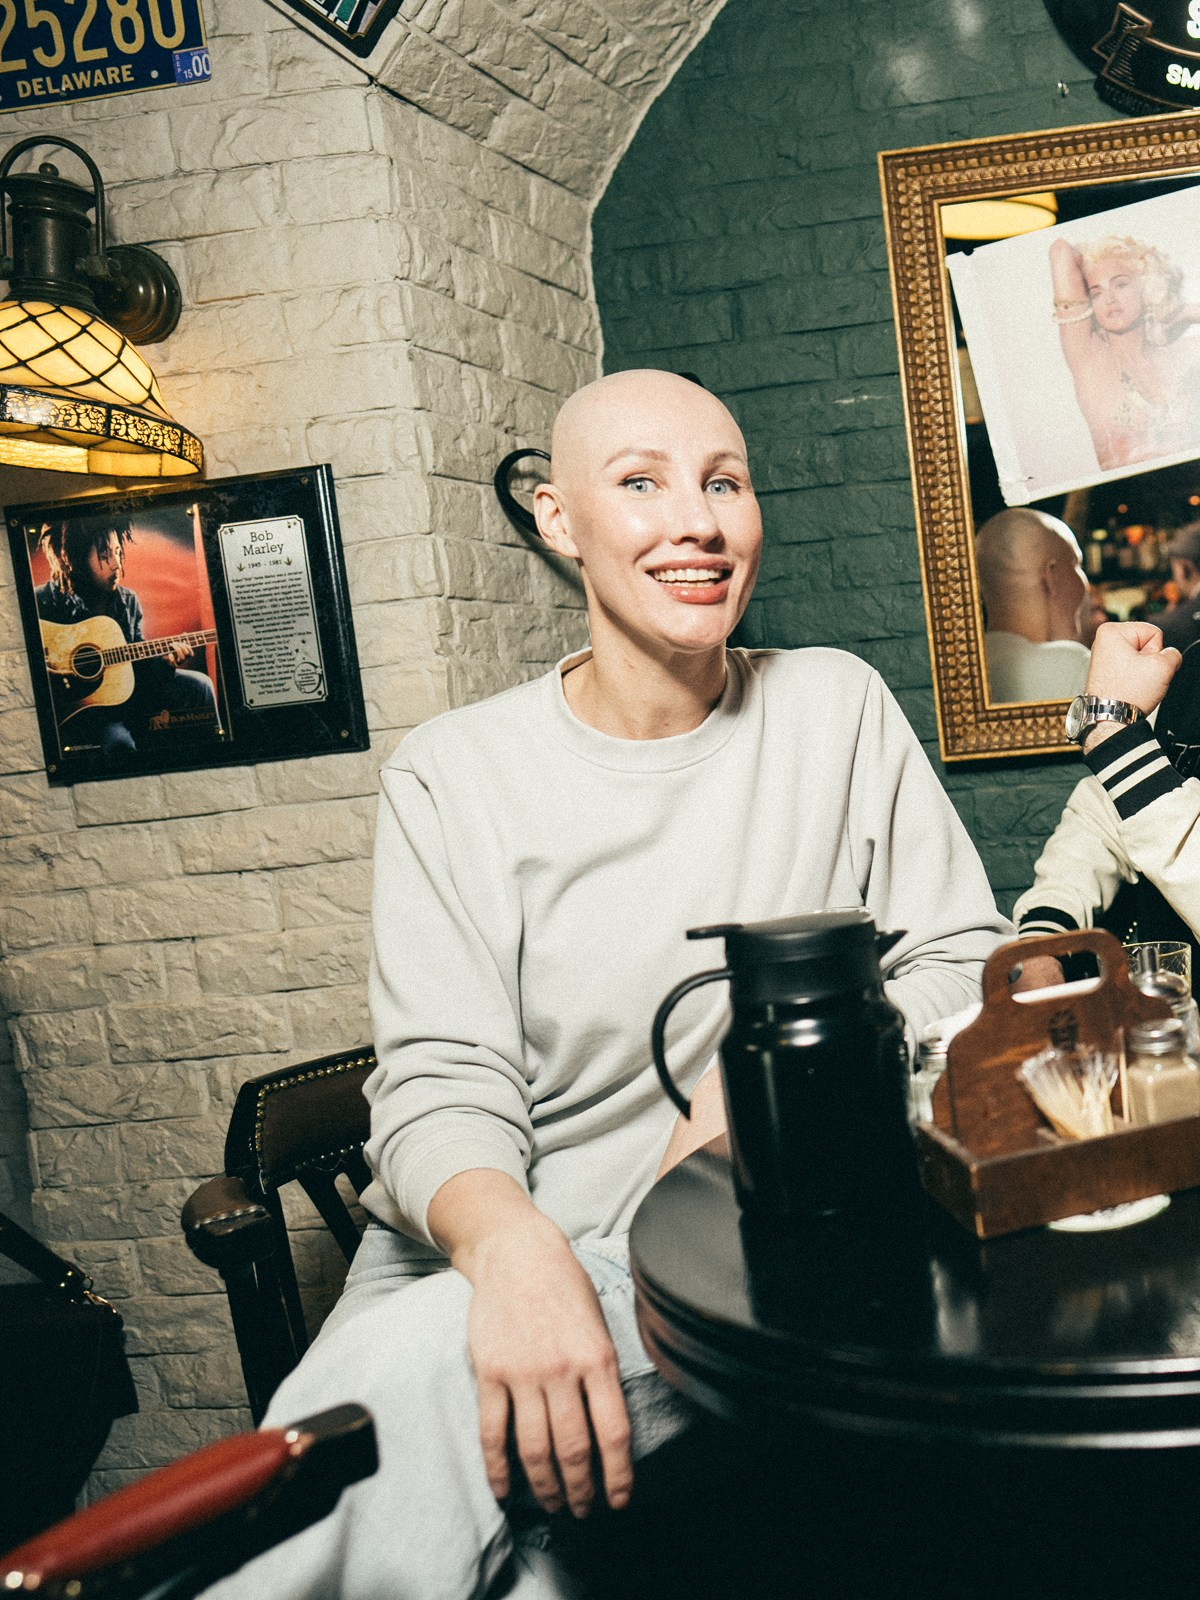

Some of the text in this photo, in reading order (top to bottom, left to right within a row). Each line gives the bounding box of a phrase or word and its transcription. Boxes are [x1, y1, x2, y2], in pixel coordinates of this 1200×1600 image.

[16, 64, 135, 98] DELAWARE
[250, 530, 274, 543] Bob
[242, 543, 284, 556] Marley
